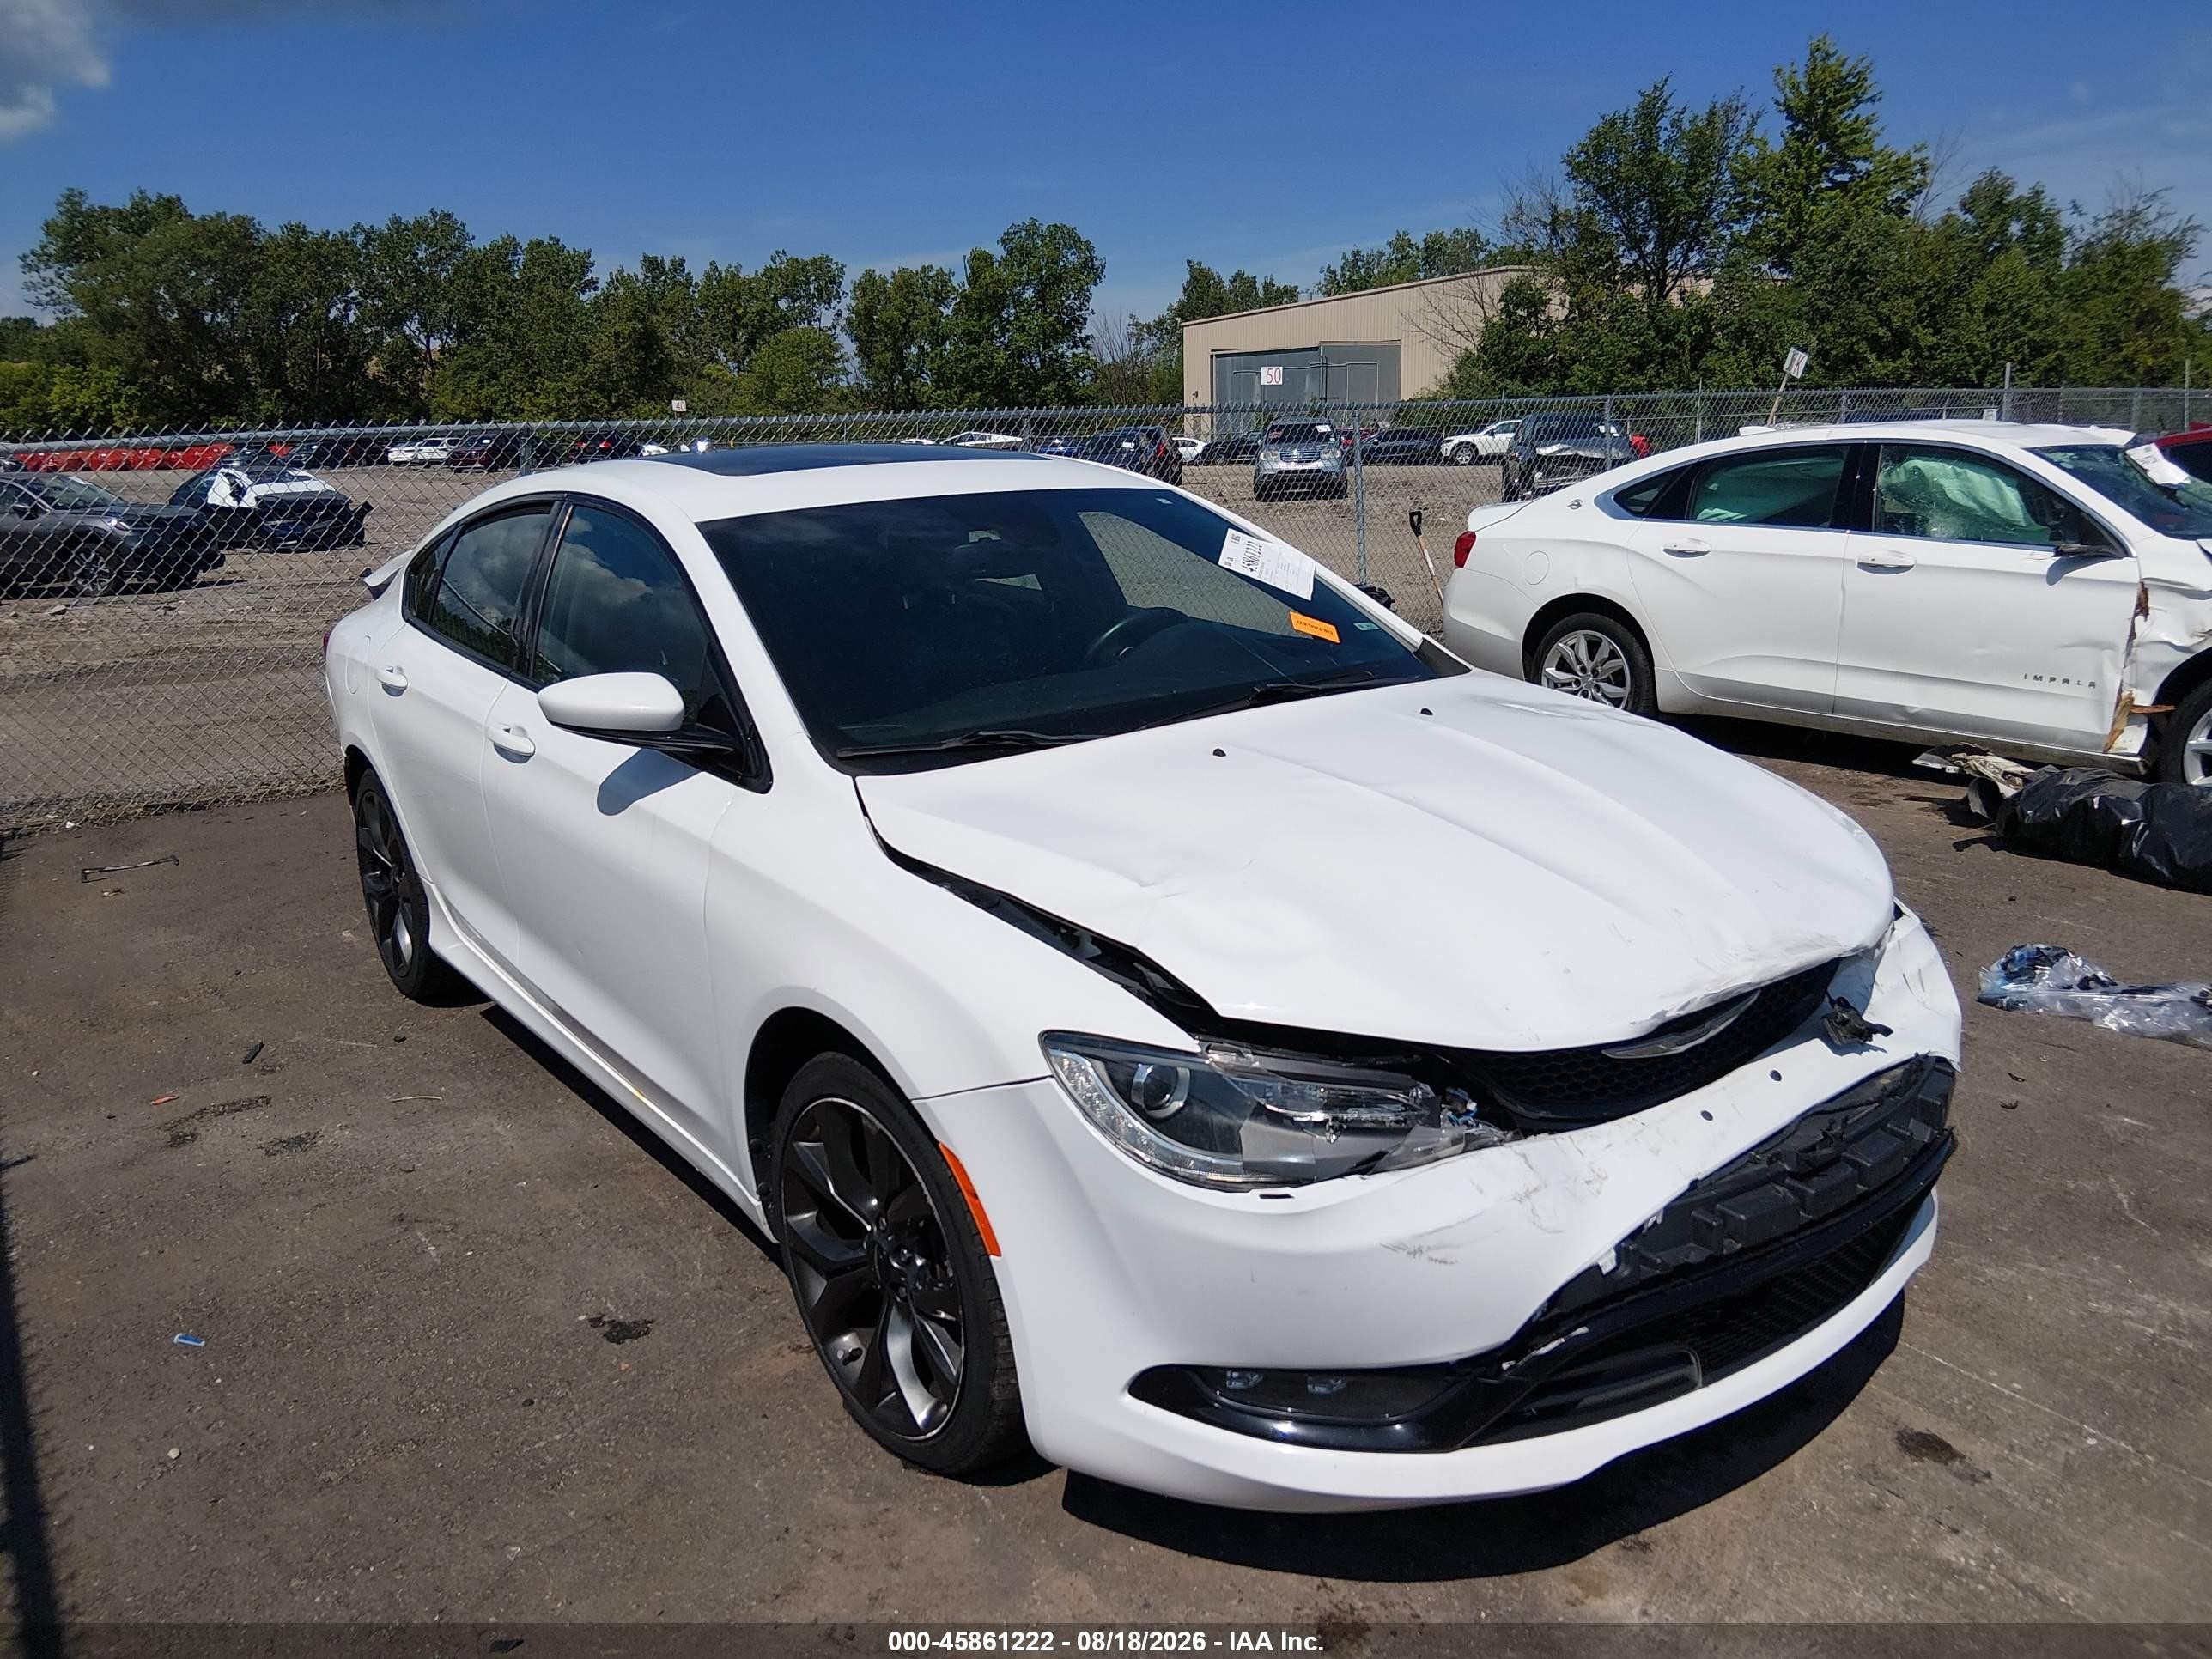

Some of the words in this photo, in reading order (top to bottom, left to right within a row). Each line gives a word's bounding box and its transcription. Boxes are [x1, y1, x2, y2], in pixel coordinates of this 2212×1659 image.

[1267, 368, 1281, 384] 50
[676, 401, 685, 411] 40
[2023, 672, 2096, 689] IMPALA
